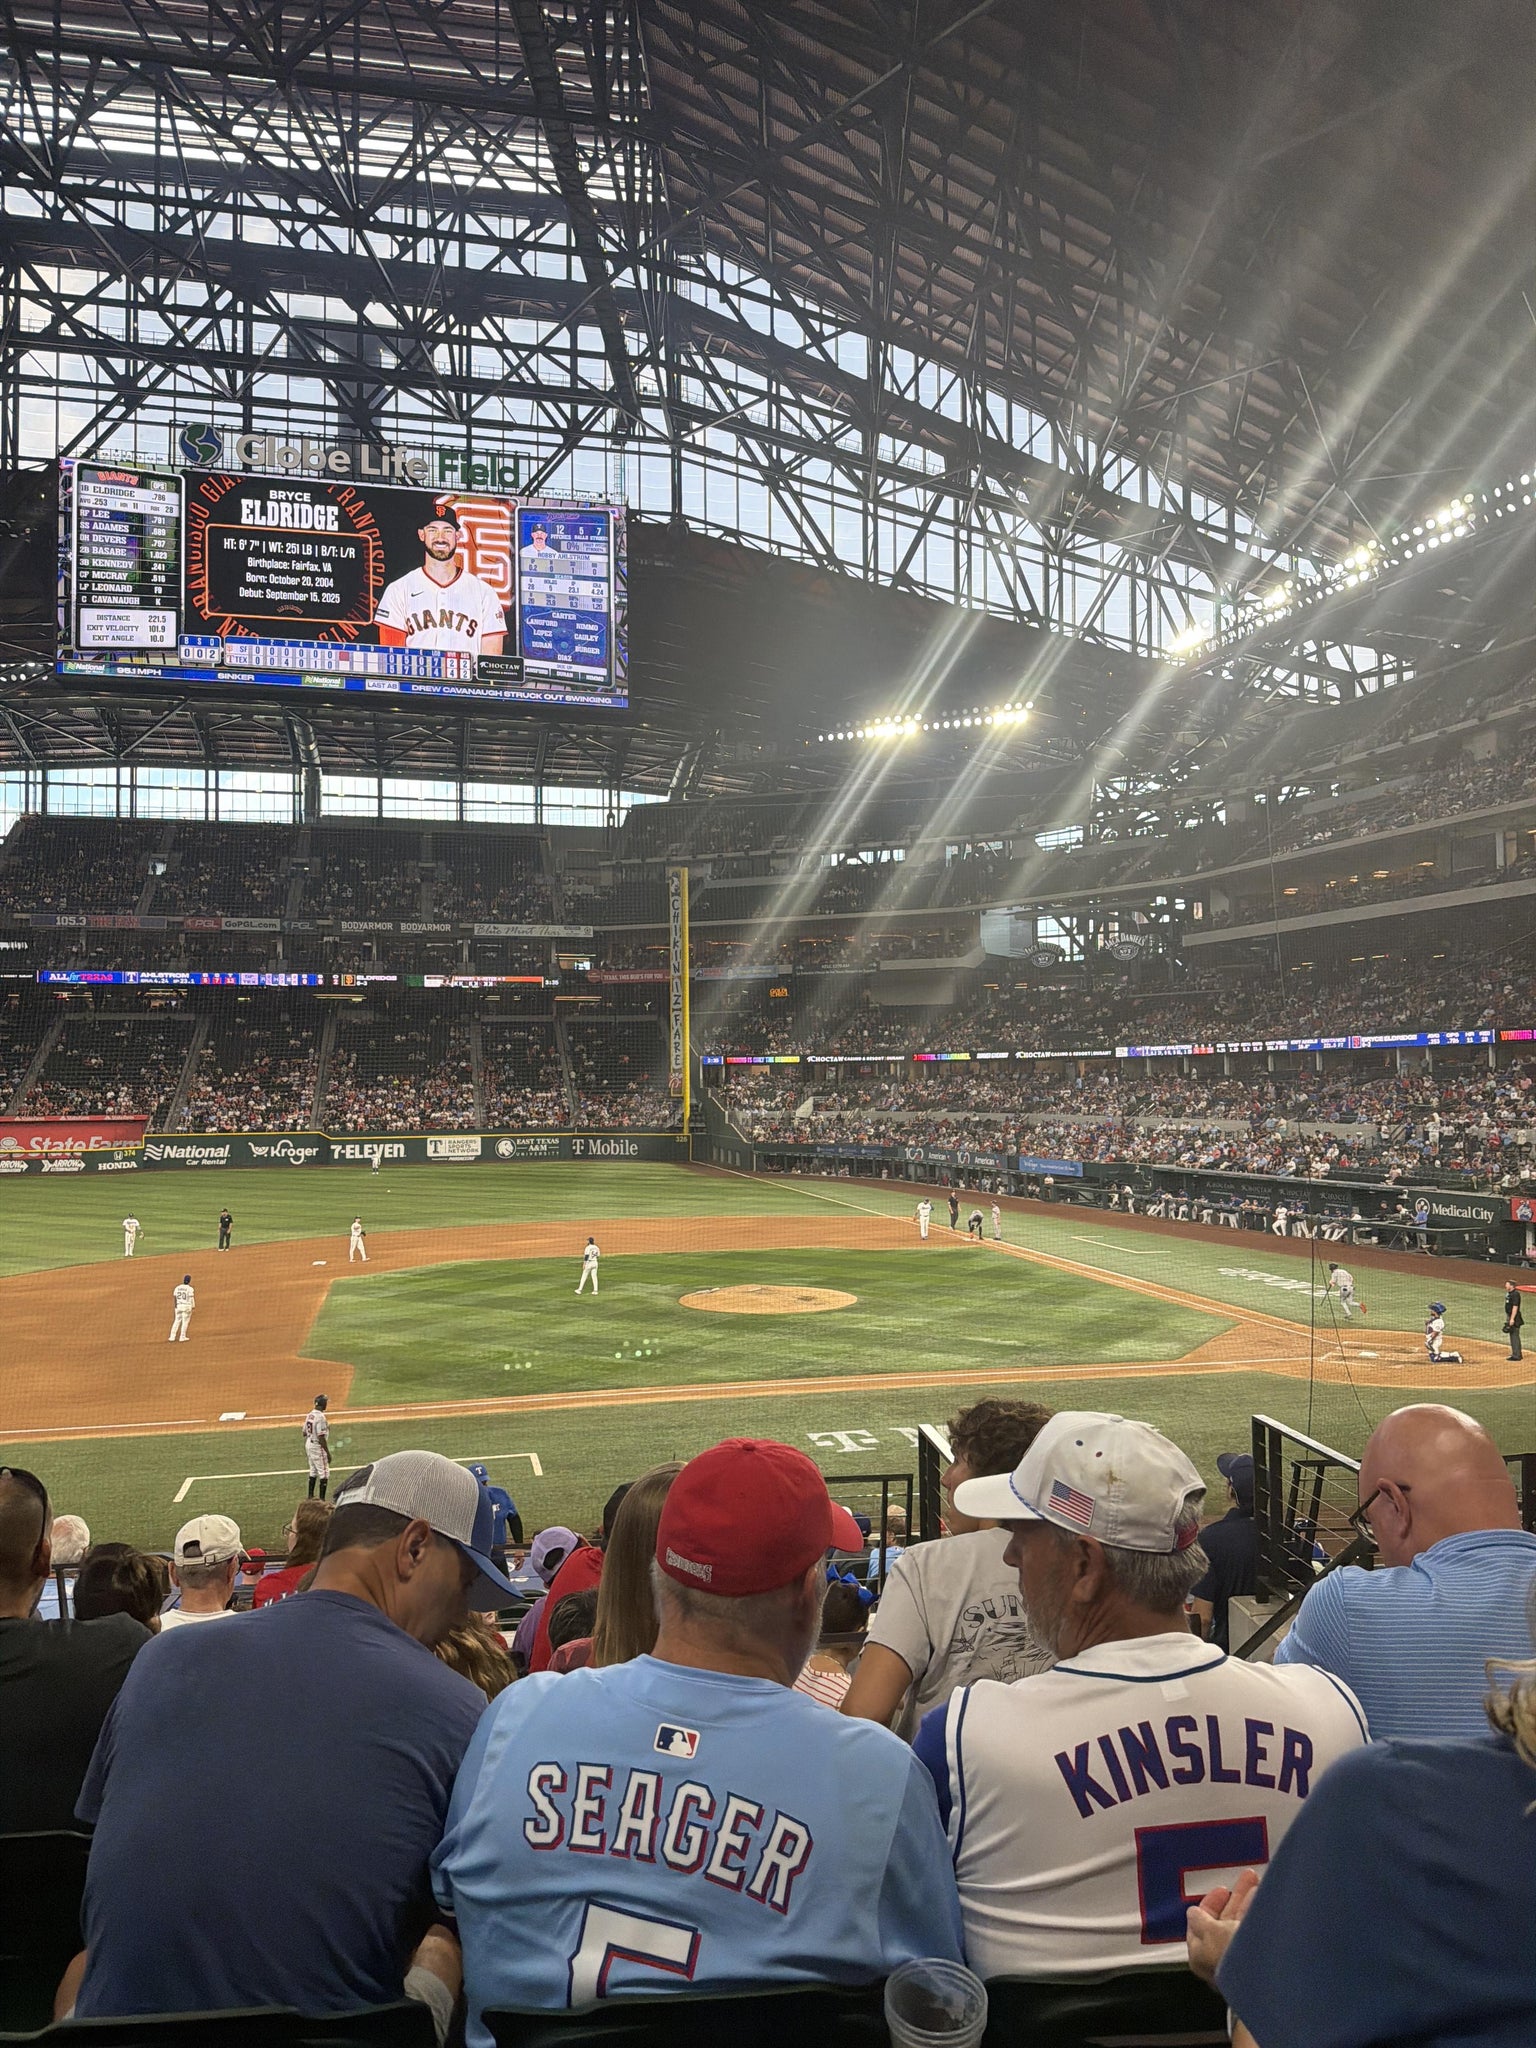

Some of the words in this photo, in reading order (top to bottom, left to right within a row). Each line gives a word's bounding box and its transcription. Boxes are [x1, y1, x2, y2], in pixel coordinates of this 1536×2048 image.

[236, 433, 350, 474] Globe
[361, 442, 428, 480] Life
[439, 450, 519, 488] Field
[97, 471, 138, 485] GIANTS
[93, 486, 135, 498] ELDRIDGE
[270, 490, 312, 502] BRYCE
[93, 510, 110, 518] LEE
[241, 499, 338, 531] ELDRIDGE
[93, 522, 129, 532] ADAMES
[556, 524, 565, 535] 12
[596, 528, 602, 536] 7
[93, 534, 126, 544] DEVERS
[93, 546, 126, 556] BASABE
[224, 538, 237, 550] HT:
[268, 542, 284, 553] WT:
[286, 543, 300, 554] 251
[302, 544, 312, 556] LB
[321, 546, 338, 557] B/T:
[340, 547, 356, 558] L/R
[566, 542, 580, 551] 0%
[92, 558, 134, 568] KENNEDY
[248, 558, 290, 570] Birthplace:
[323, 562, 332, 572] VA
[92, 571, 128, 580] MCCRAY
[246, 572, 268, 584] Born:
[270, 574, 300, 586] October
[316, 576, 334, 588] 2004
[92, 583, 132, 592] LEONARD
[92, 595, 140, 604] CAVANAUGH
[239, 587, 264, 599] Debut:
[266, 588, 308, 602] September
[322, 592, 340, 604] 2025
[407, 609, 478, 638] GIANTS
[574, 634, 598, 642] CAULEY
[184, 648, 190, 658] 0
[197, 649, 202, 658] 0
[210, 650, 215, 658] 2
[574, 646, 600, 654] BURGER
[236, 656, 248, 664] TEX
[434, 658, 440, 667] 7
[480, 662, 520, 670] CHOCTAW
[218, 672, 255, 681] SINKER
[368, 681, 386, 689] LAST
[412, 685, 442, 693] DREW
[443, 686, 502, 697] CAVANAUGH
[504, 690, 542, 699] STRUCK
[544, 692, 564, 700] OUT
[566, 694, 612, 704] SWINGING
[56, 916, 86, 926] 105.3
[194, 920, 218, 928] PGL
[224, 920, 277, 929] GoPGL.com
[290, 922, 314, 930] PGL
[342, 921, 394, 930] BODYARMOR
[400, 922, 452, 932] BODYARMOR
[476, 924, 502, 935] Blue
[505, 926, 534, 935] Mint
[671, 899, 681, 975] CHIKIN
[1104, 936, 1120, 950] JACK
[49, 973, 69, 981] ALL
[68, 973, 80, 982] for
[80, 974, 114, 982] TEXAS
[672, 1014, 682, 1066] FARE
[1015, 1050, 1050, 1058] CHOCTAW
[30, 1137, 88, 1158] State
[88, 1136, 142, 1150] Farm
[164, 1144, 230, 1158] National
[271, 1140, 319, 1164] Kroger
[588, 1138, 638, 1156] Mobile
[928, 1152, 946, 1160] American
[974, 1156, 995, 1166] American
[98, 1161, 138, 1170] HONDA
[1432, 1202, 1472, 1218] Medical
[1472, 1206, 1494, 1224] City
[475, 1466, 482, 1474] T
[1054, 1714, 1314, 1819] KINSLER
[523, 1760, 814, 1916] SEAGER
